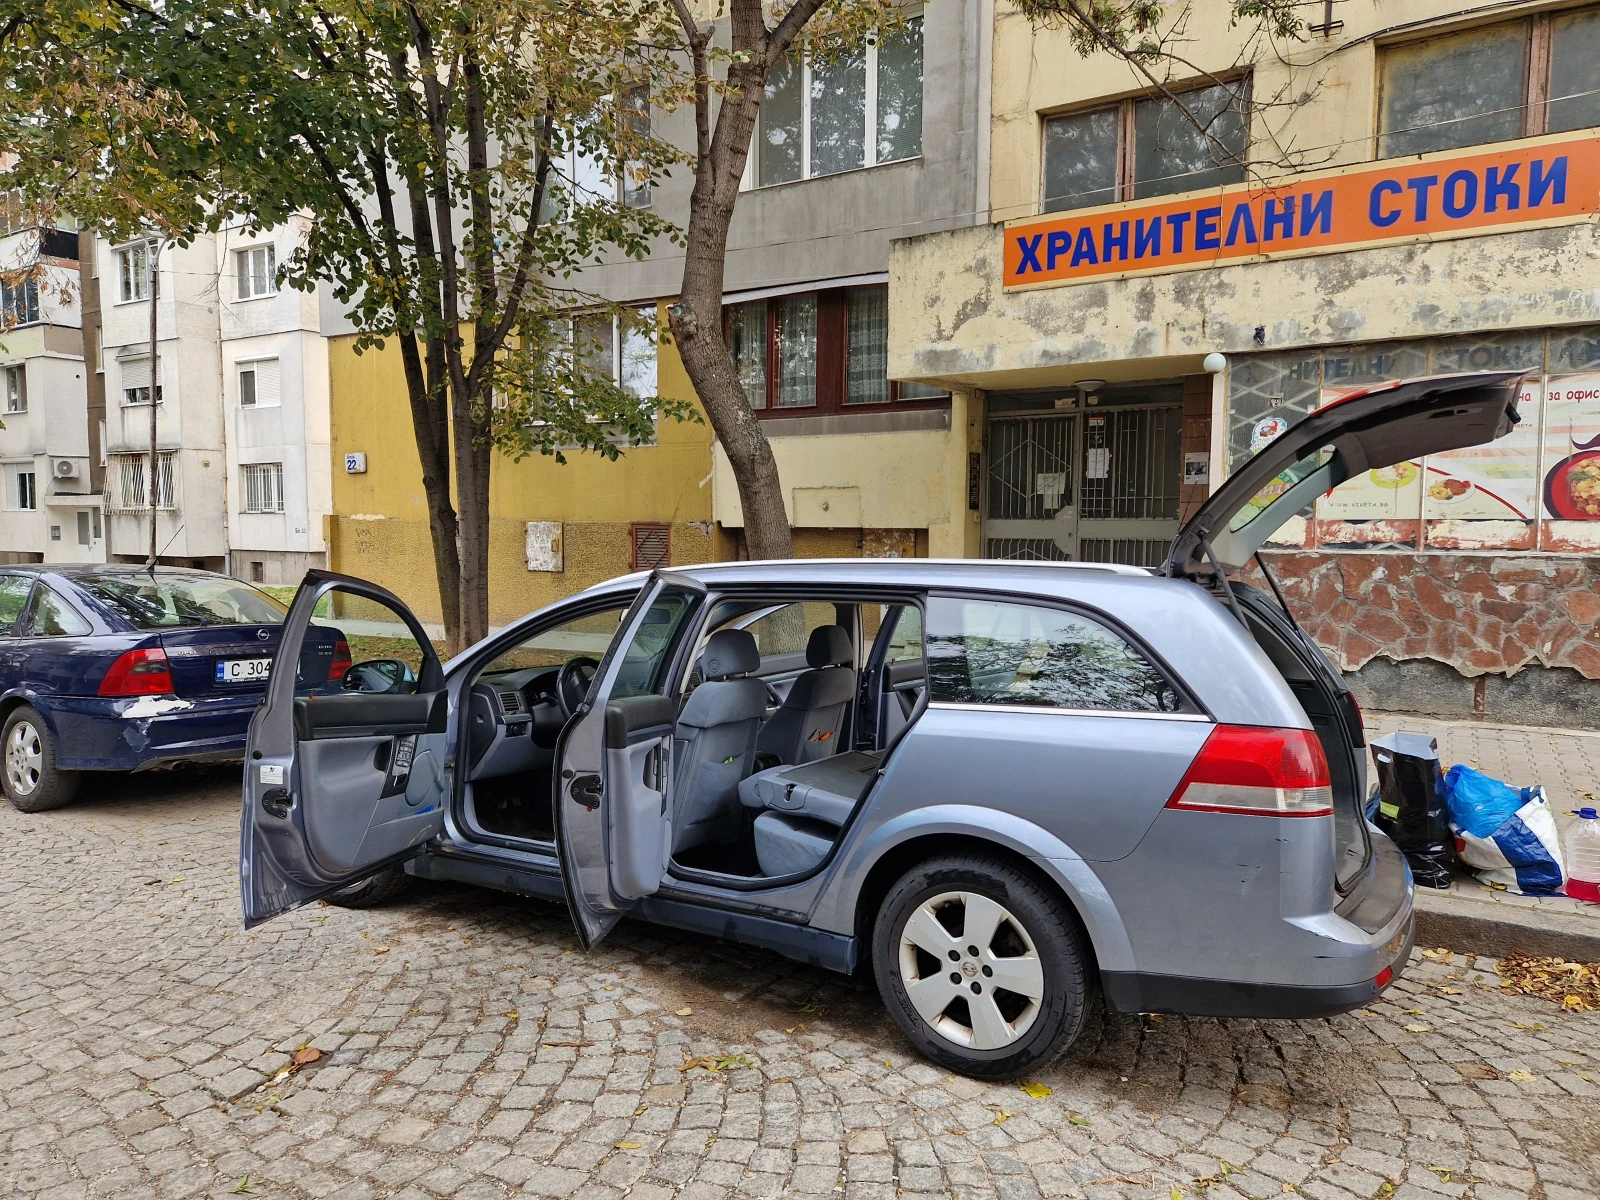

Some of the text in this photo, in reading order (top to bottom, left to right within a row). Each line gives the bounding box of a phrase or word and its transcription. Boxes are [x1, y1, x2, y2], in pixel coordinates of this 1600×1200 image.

[1015, 155, 1568, 275] ХРАНИТЕЛНИ СТОКИ
[1548, 391, 1561, 401] за
[1566, 389, 1600, 403] офис
[347, 459, 356, 470] 22
[231, 662, 241, 677] C
